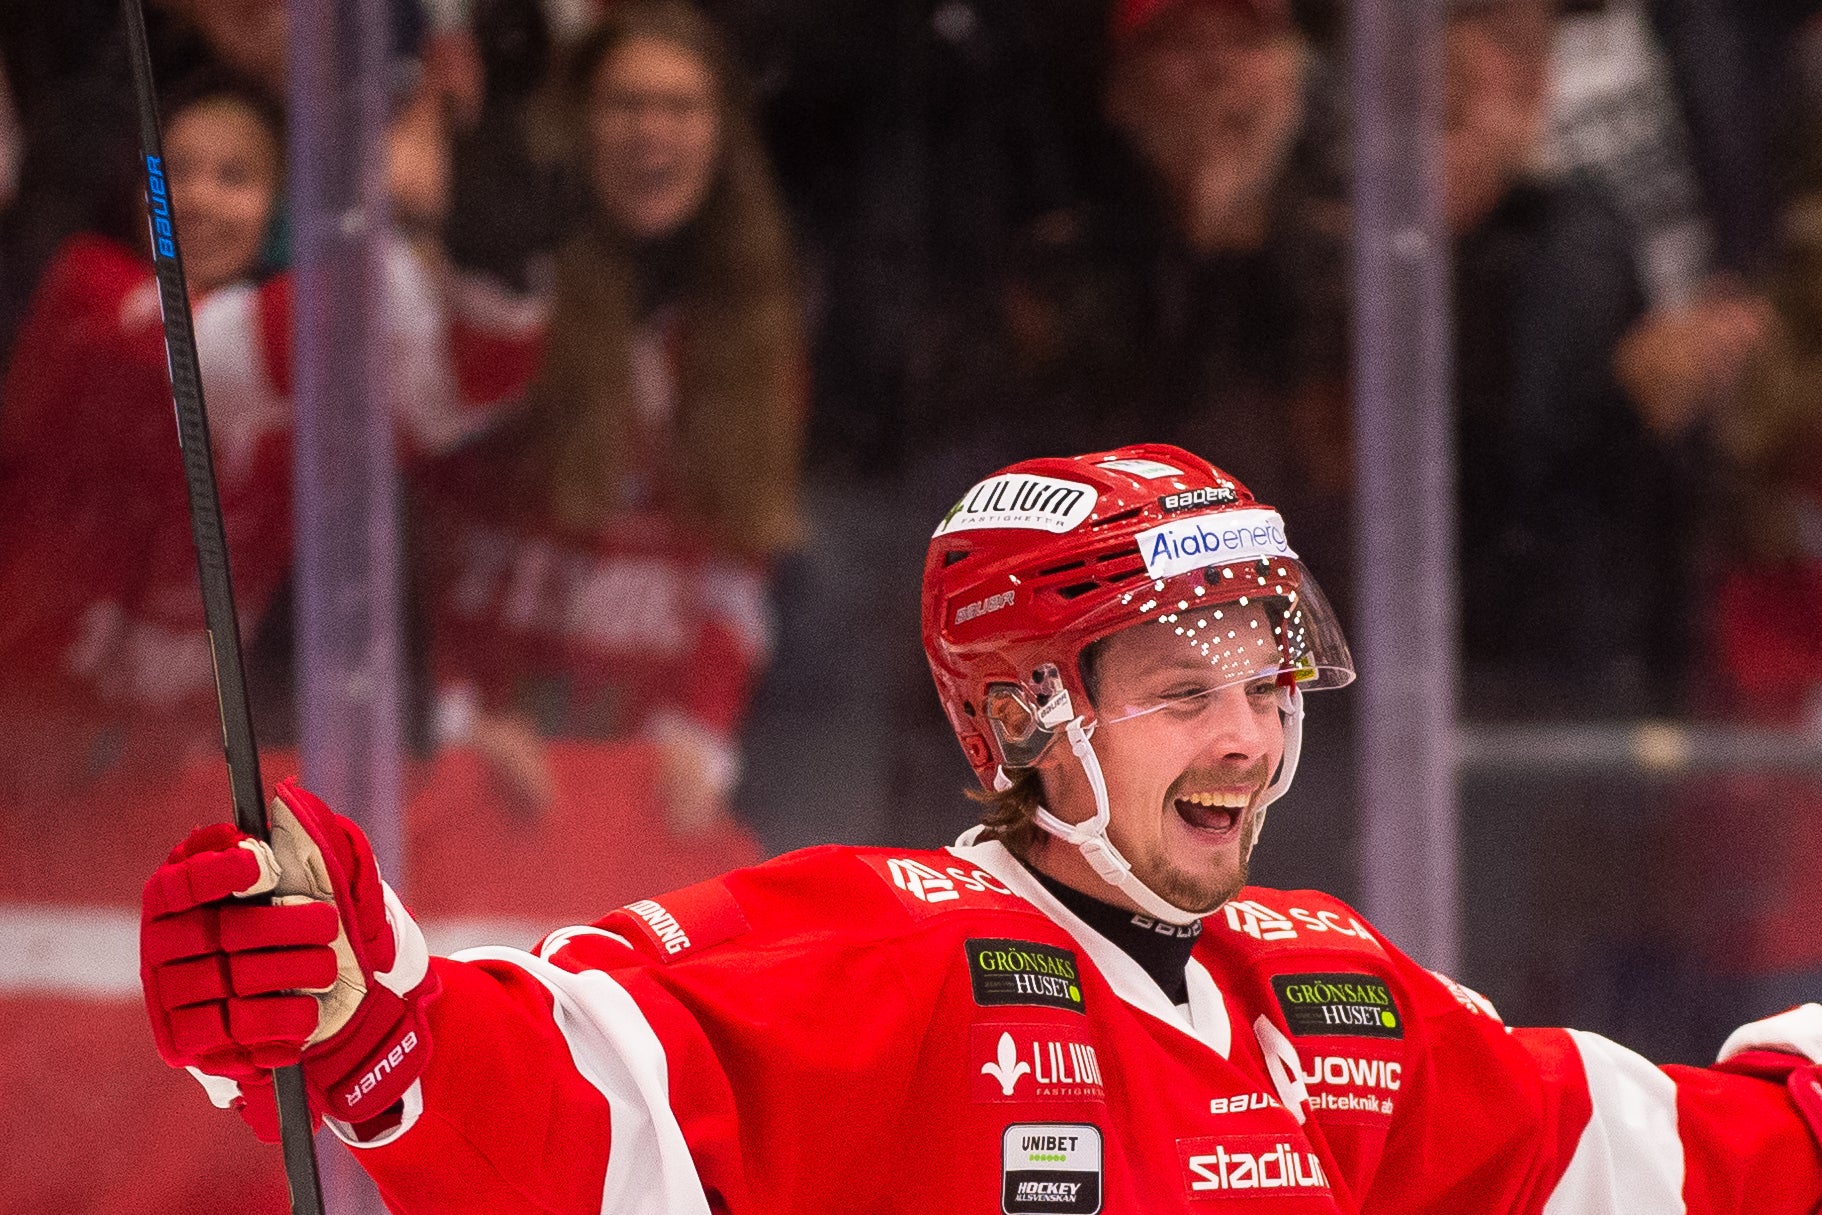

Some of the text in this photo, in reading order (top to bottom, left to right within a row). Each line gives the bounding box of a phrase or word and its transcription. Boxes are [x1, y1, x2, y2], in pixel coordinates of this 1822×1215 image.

[966, 480, 1085, 517] LILIUM
[979, 948, 1075, 980] GRÖNSAKS
[1014, 974, 1070, 999] HUSET
[1286, 981, 1389, 1005] GRÖNSAKS
[1322, 1005, 1381, 1026] HUSET
[1302, 1056, 1402, 1090] JOWIC
[1021, 1136, 1079, 1152] UNIBET
[1018, 1182, 1082, 1195] HOCKEY
